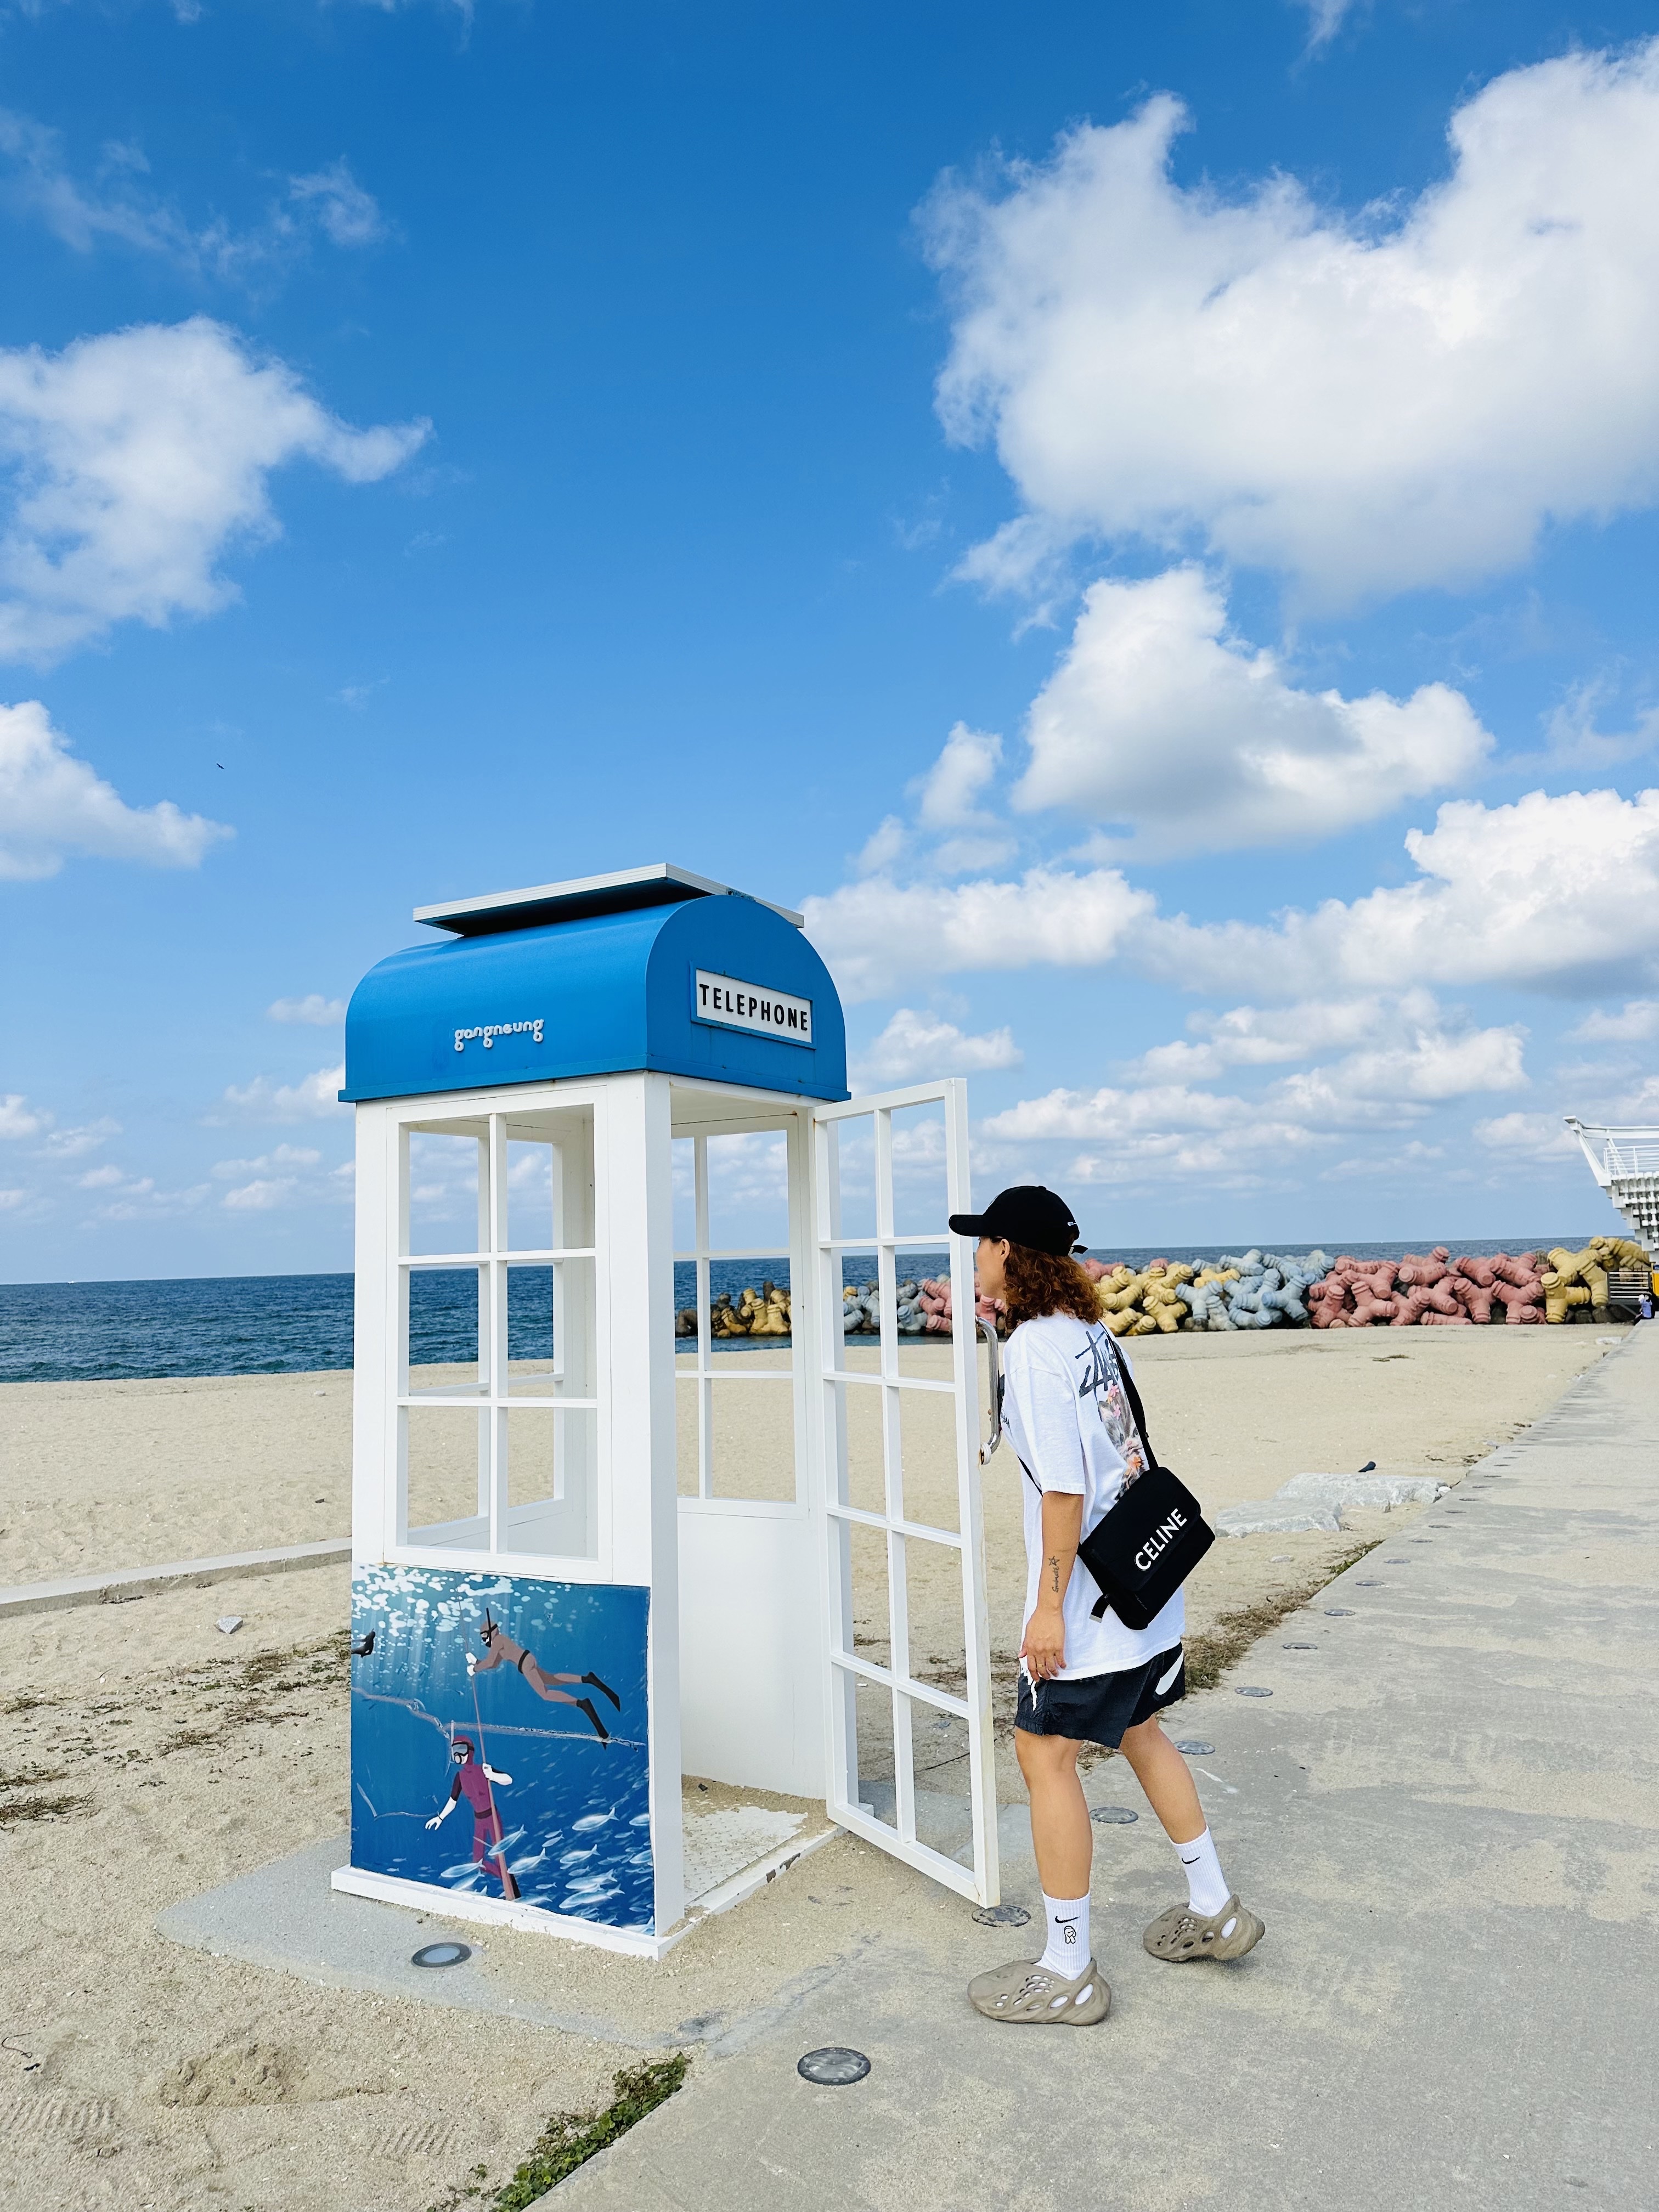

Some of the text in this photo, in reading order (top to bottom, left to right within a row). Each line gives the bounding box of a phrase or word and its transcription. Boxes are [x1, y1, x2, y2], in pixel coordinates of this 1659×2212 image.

[699, 984, 808, 1031] TELEPHONE
[454, 1019, 544, 1052] gangneung
[1135, 1508, 1187, 1570] CELINE
